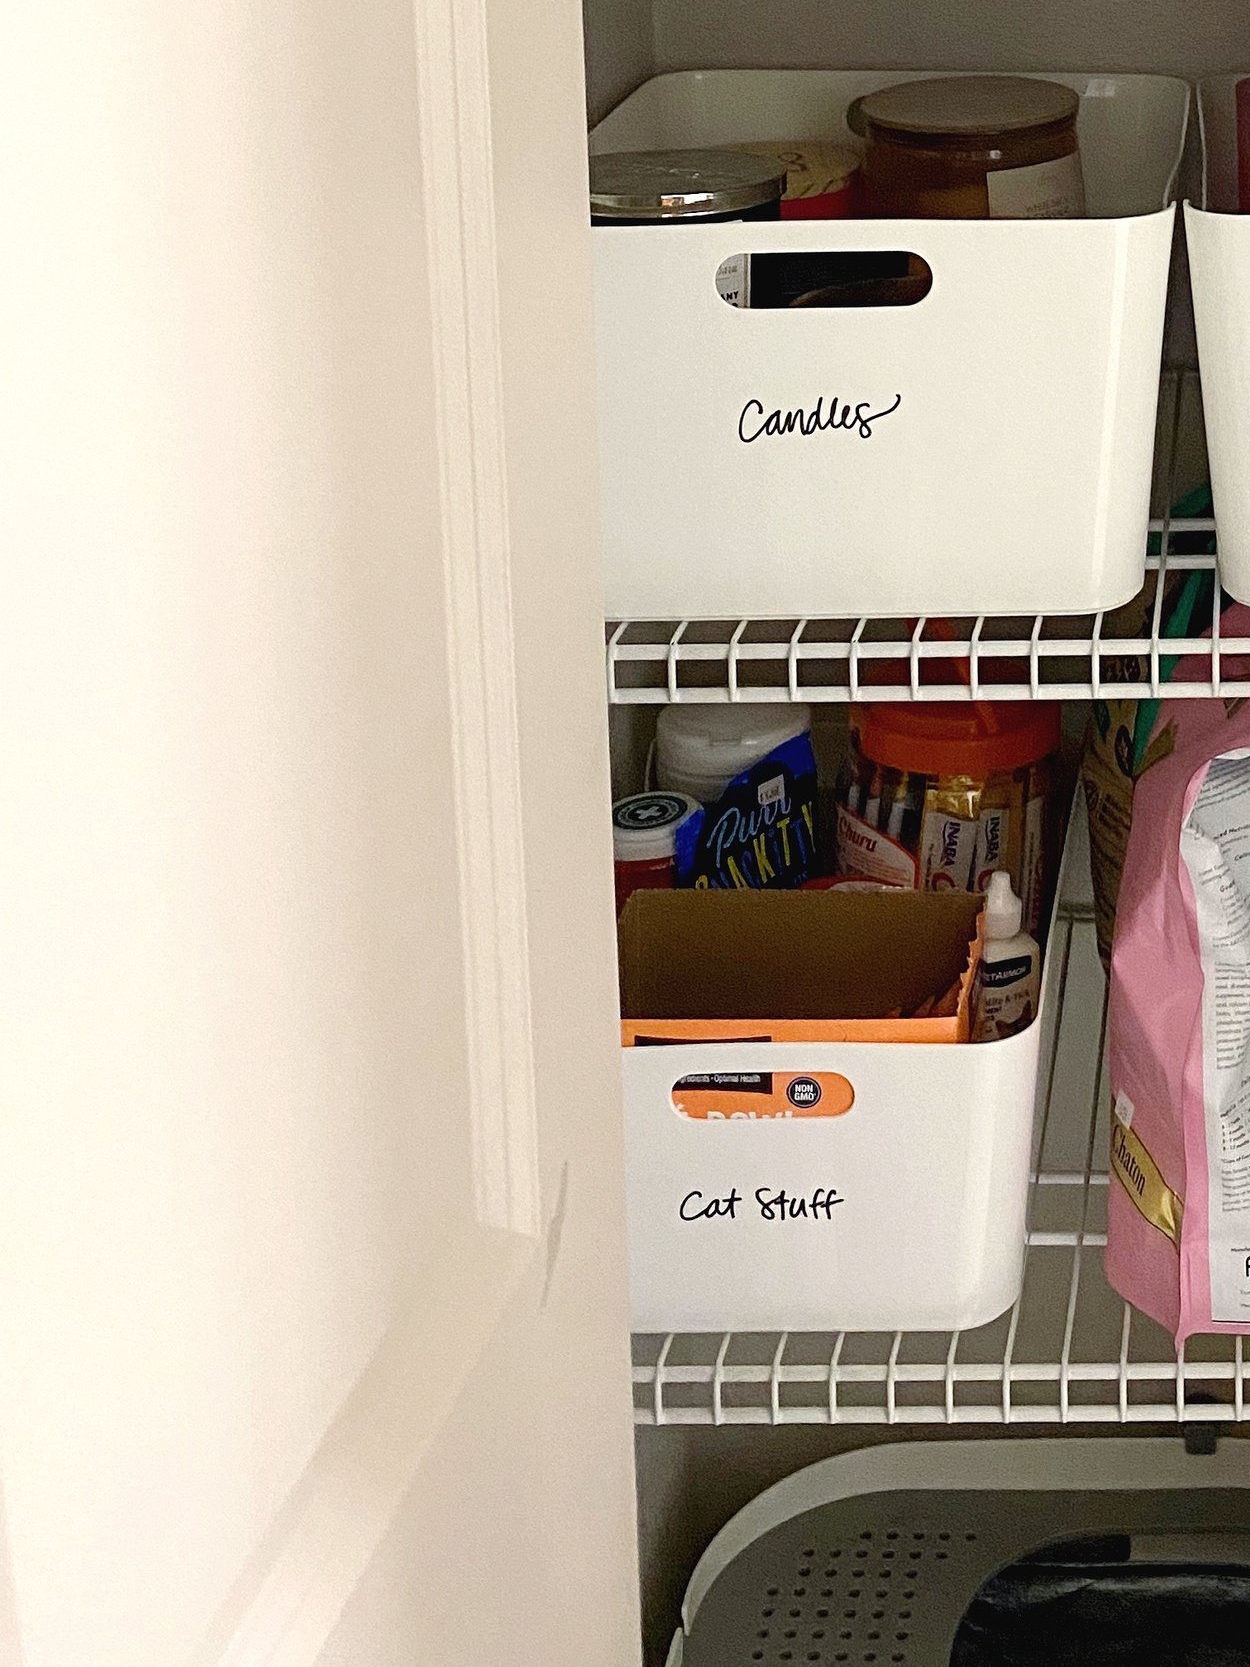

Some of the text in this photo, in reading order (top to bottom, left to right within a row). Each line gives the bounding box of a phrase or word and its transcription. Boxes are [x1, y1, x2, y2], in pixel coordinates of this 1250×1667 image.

[738, 394, 901, 443] Candles
[839, 816, 878, 853] Churu
[943, 821, 961, 867] INABA
[984, 816, 1001, 862] INABA
[794, 1084, 813, 1093] NON
[1110, 1124, 1146, 1196] Chaton
[679, 1187, 844, 1222] Cat Stuff
